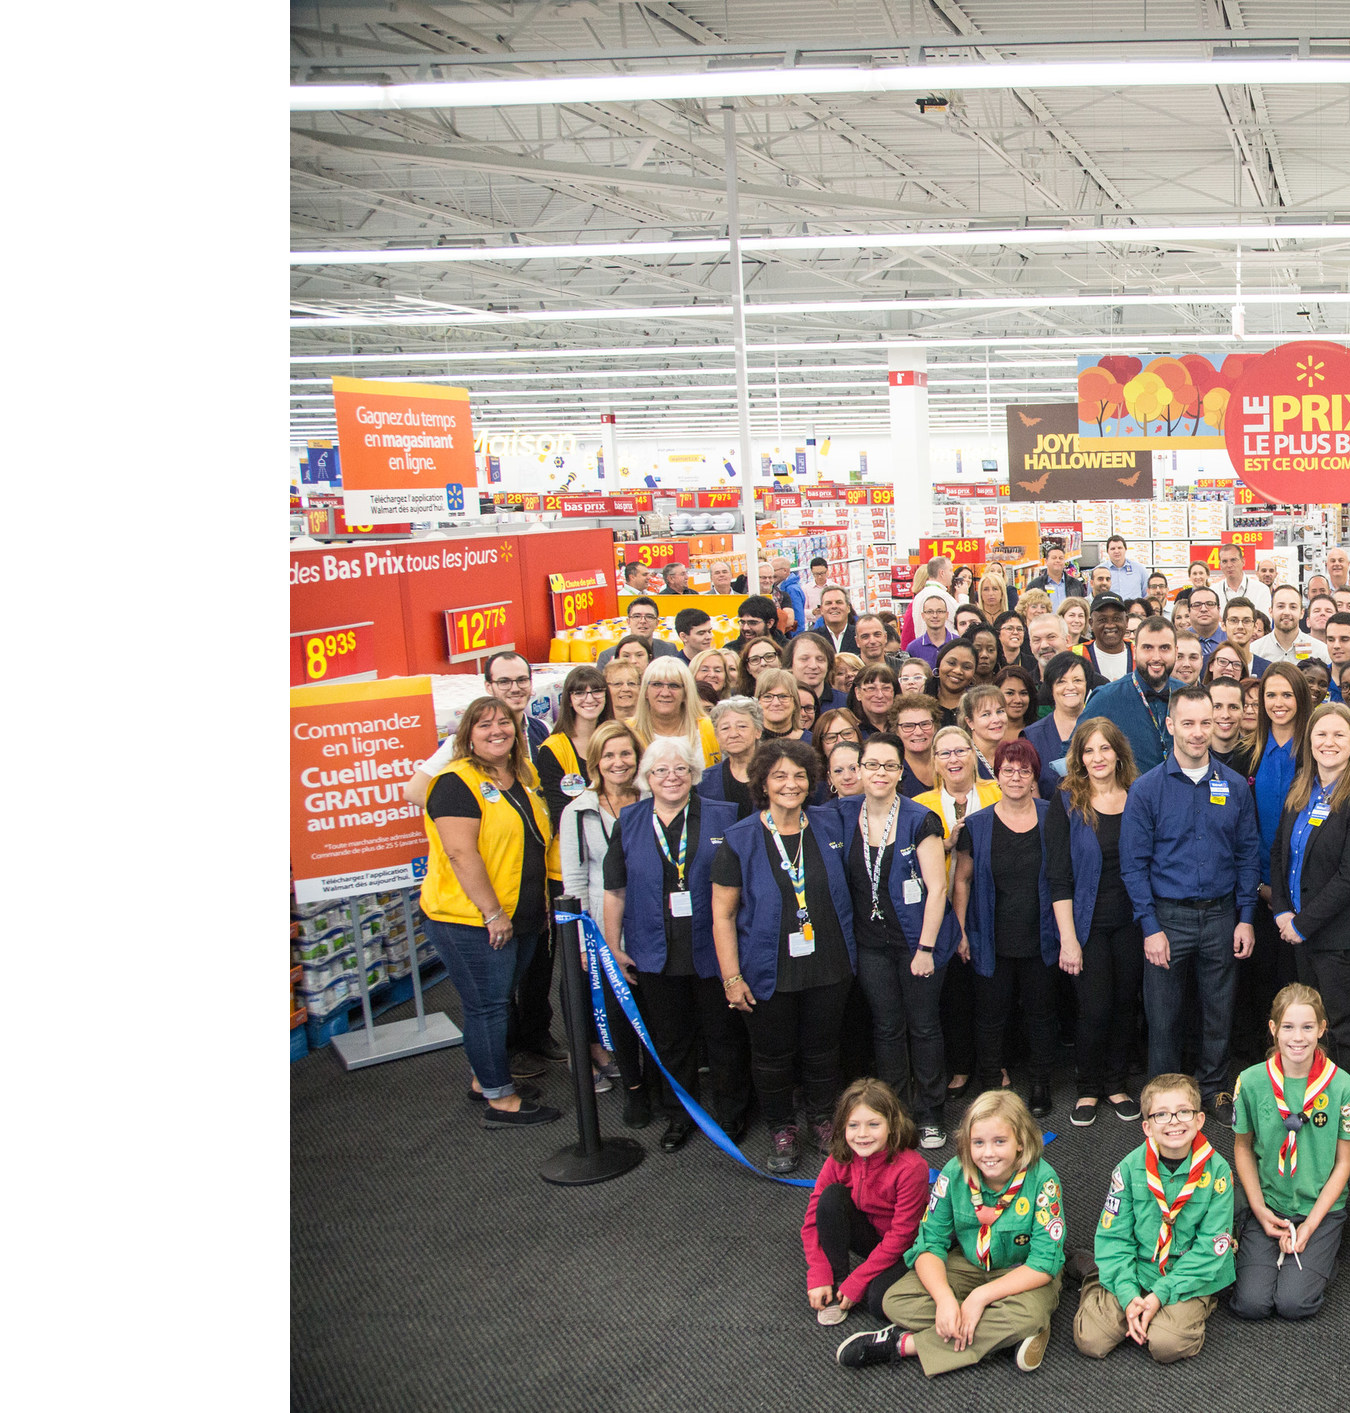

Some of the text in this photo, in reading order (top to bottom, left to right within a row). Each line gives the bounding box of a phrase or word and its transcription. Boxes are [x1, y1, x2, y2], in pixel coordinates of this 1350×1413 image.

[356, 406, 456, 432] Gagnez du temps
[1243, 396, 1270, 433] LE
[365, 431, 454, 452] en magasinant
[1033, 433, 1080, 453] JOY
[1244, 435, 1270, 455] LE
[1275, 434, 1331, 455] PLUS
[389, 453, 437, 475] en ligne.
[1024, 452, 1136, 470] HALLOWEEN
[1244, 458, 1270, 471] EST
[1272, 457, 1291, 471] CE
[1293, 457, 1319, 473] QUI
[370, 494, 443, 504] Téléchargez l'application
[708, 494, 731, 507] 797$
[820, 490, 832, 498] prix
[947, 487, 970, 496] bas prix
[371, 506, 398, 514] Walmart
[410, 504, 444, 515] aujourd'hui.
[564, 502, 605, 513] bas prix
[614, 501, 624, 510] bas
[638, 545, 674, 567] 398$
[928, 539, 979, 562] 1548$
[290, 547, 498, 585] des Bas Prix tous les jours
[566, 577, 596, 588] Chute de prix
[563, 591, 594, 627] 898$
[458, 607, 506, 650] 1277$
[307, 630, 357, 680] 893$
[293, 713, 421, 740] Commandez
[322, 737, 404, 757] en ligne.
[307, 817, 335, 832] au
[311, 849, 351, 860] Commande
[322, 868, 408, 886] Téléchargez l'application
[323, 883, 354, 892] Walmart
[369, 875, 410, 887] aujourd'hui.
[588, 948, 601, 990] Walmart
[600, 945, 622, 988] Walmart
